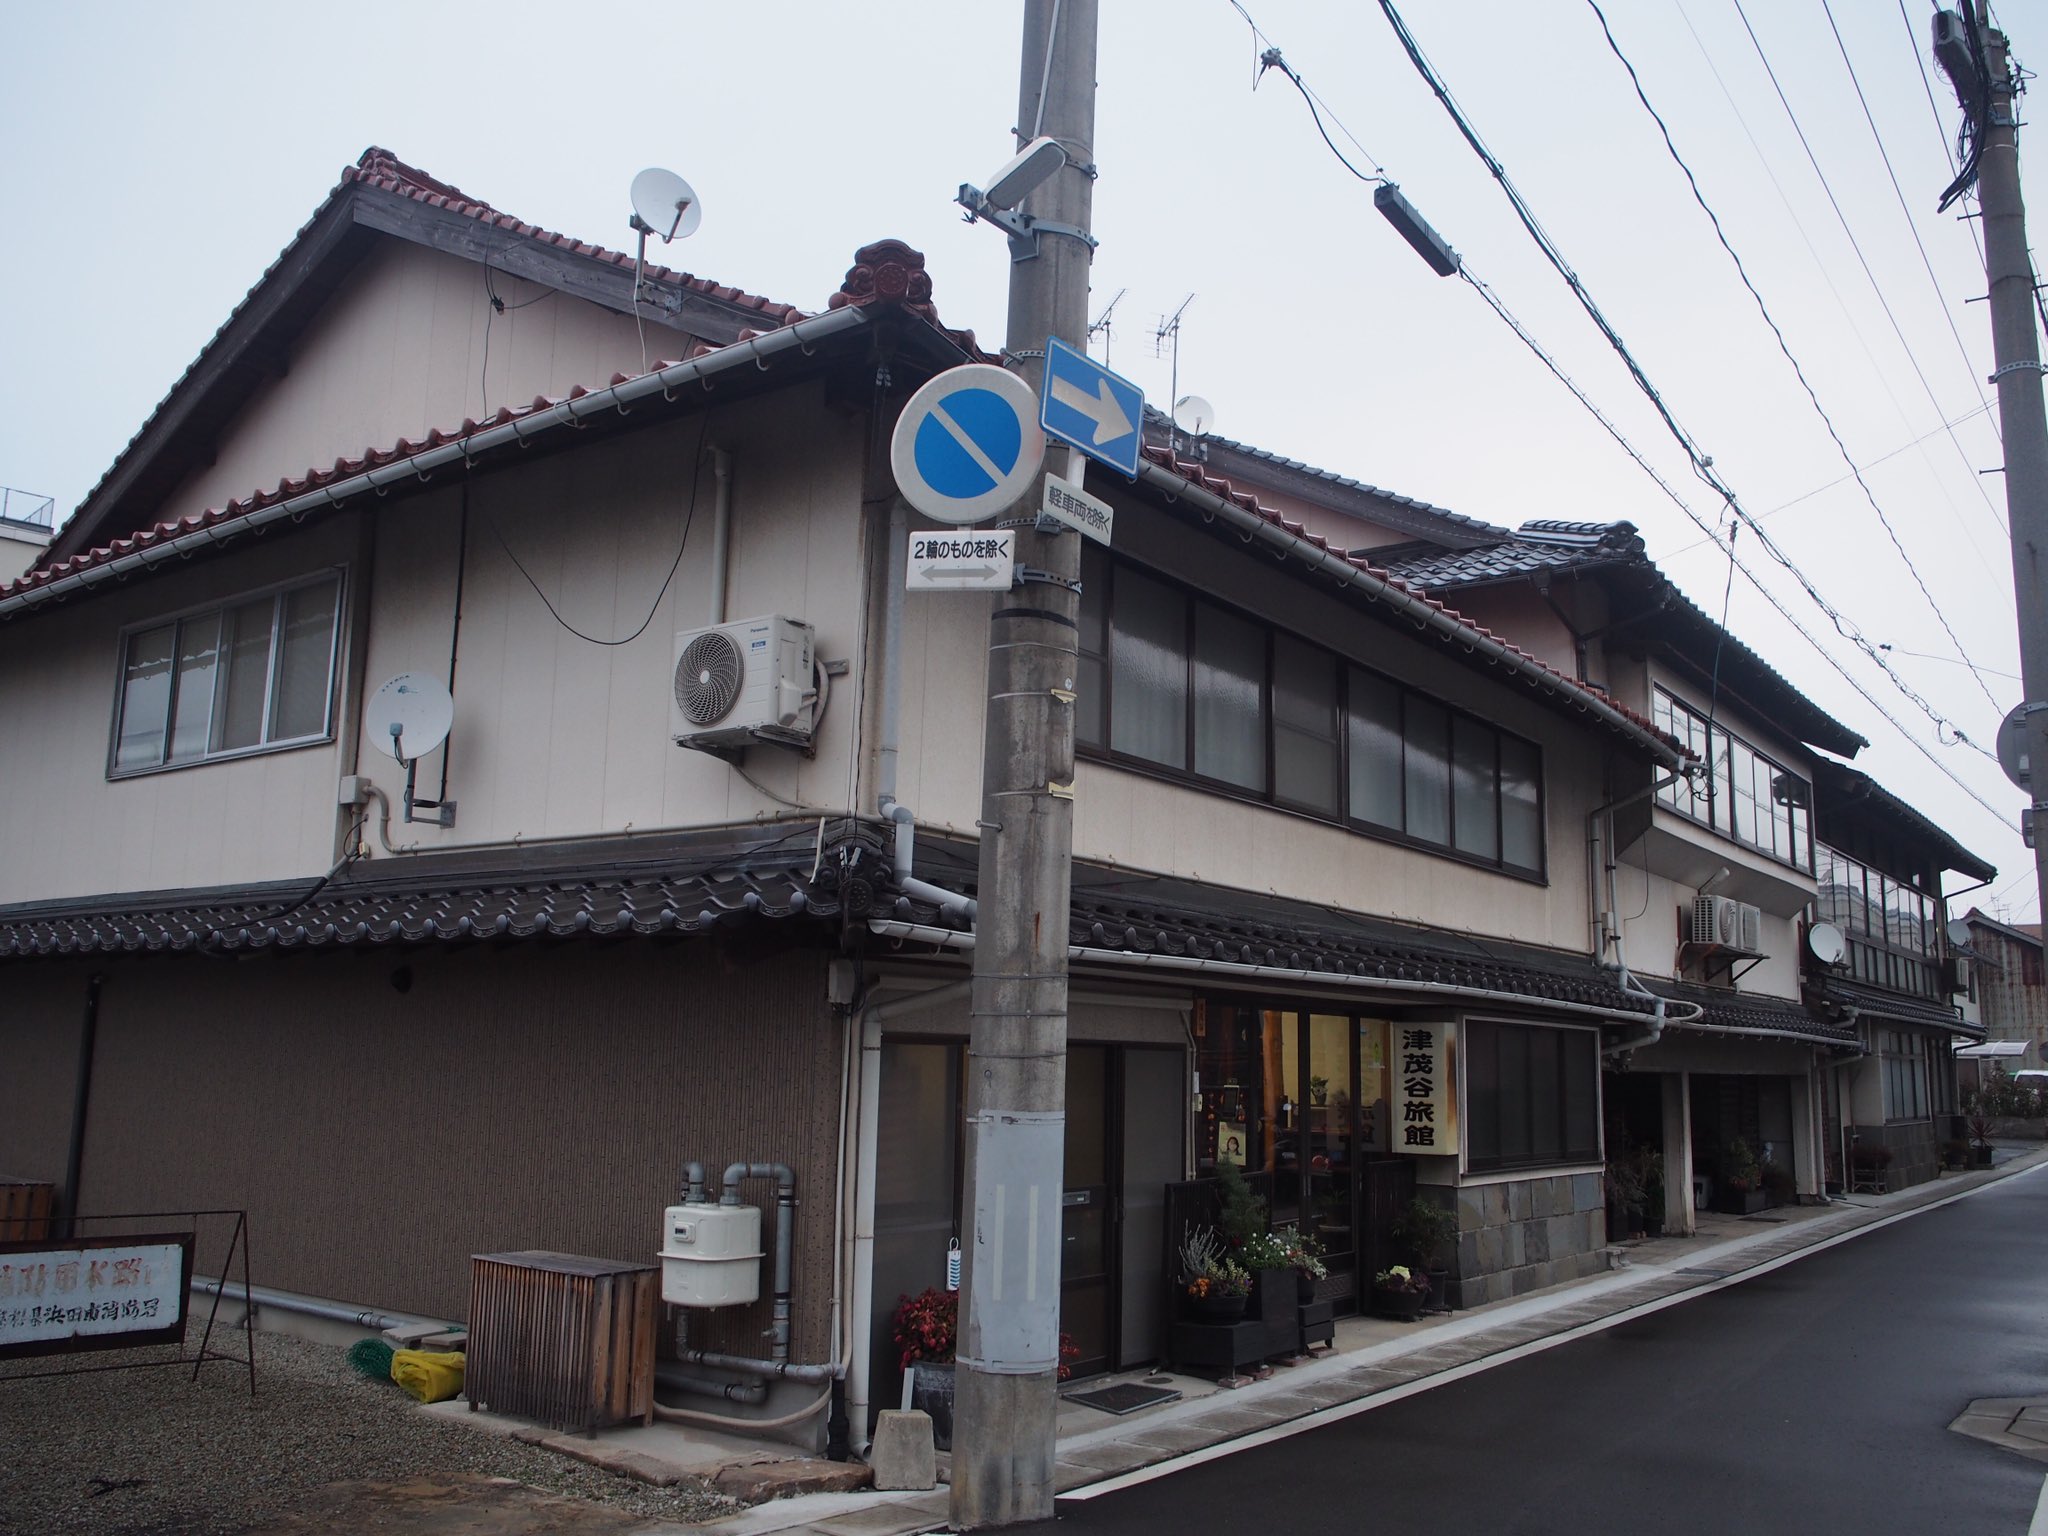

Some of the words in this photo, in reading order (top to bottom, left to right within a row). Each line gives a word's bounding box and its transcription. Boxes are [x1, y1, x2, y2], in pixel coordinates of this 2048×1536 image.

[1048, 484, 1112, 534] 軽車両を除く
[1402, 1029, 1435, 1146] 津茂谷旅館
